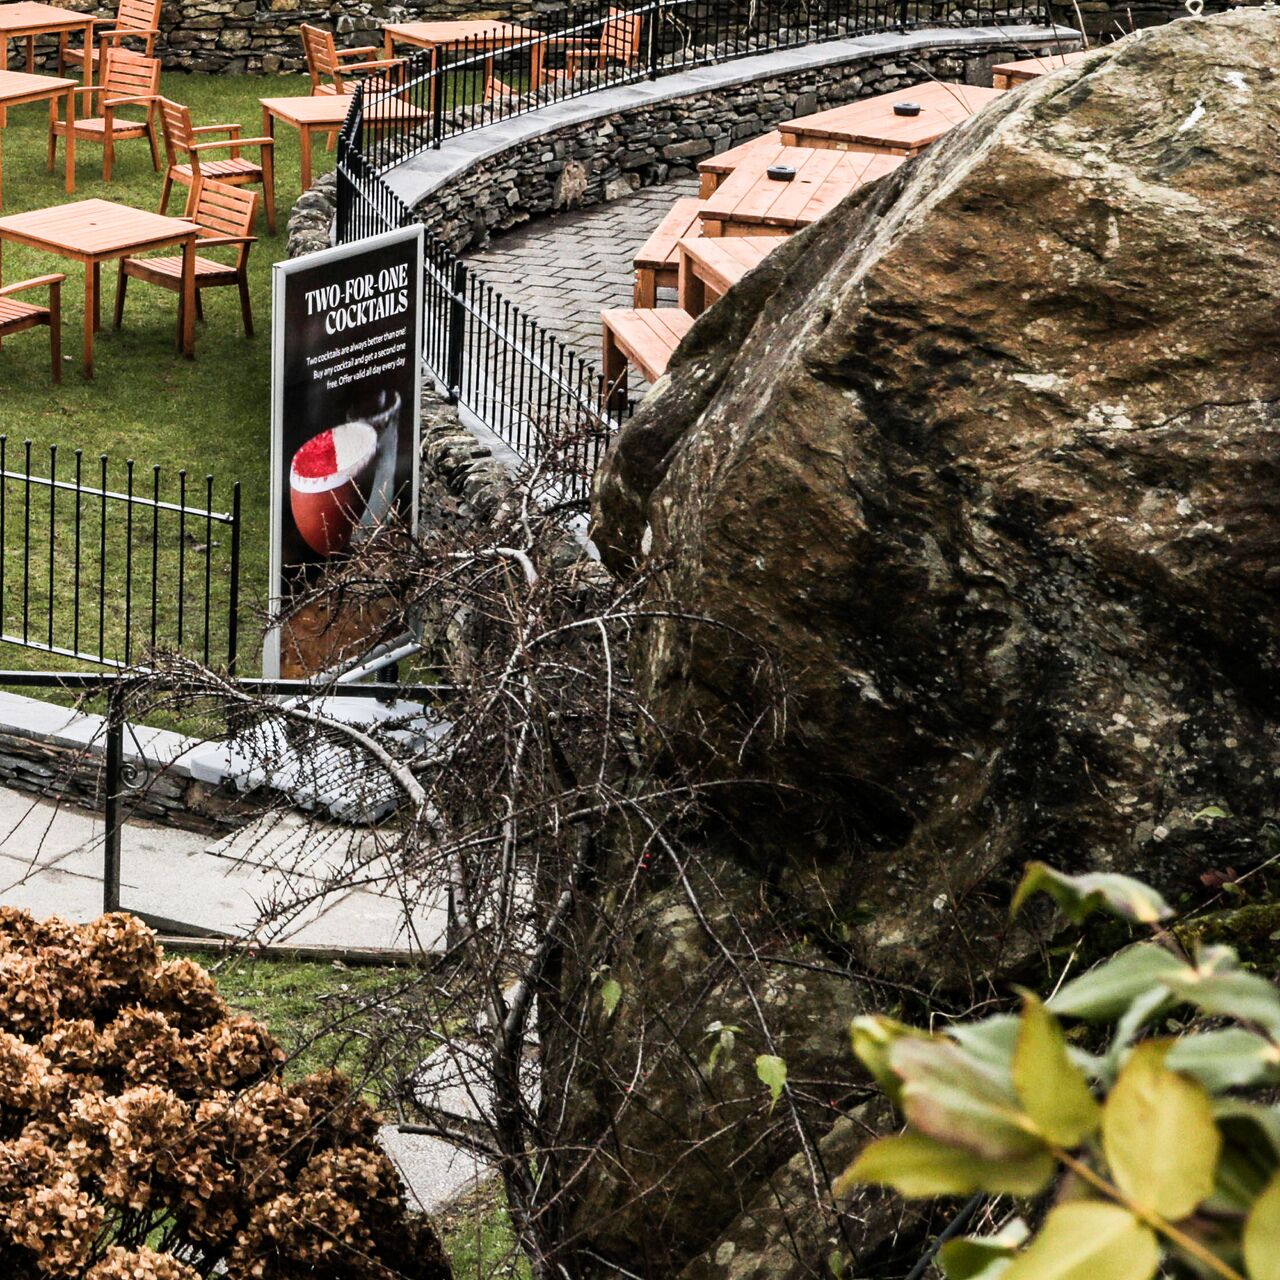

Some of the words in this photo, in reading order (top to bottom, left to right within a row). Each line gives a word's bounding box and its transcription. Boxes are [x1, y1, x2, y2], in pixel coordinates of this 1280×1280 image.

[305, 263, 408, 315] TWO-FOR-ONE
[325, 289, 408, 335] COCKTAILS
[306, 357, 317, 366] Two
[318, 348, 340, 363] cocktails
[341, 346, 349, 355] are
[350, 342, 367, 353] always
[368, 335, 383, 347] better
[384, 331, 395, 341] than
[313, 370, 323, 380] Buy
[323, 367, 333, 376] any
[334, 358, 354, 373] cocktail
[354, 354, 364, 365] and
[365, 353, 373, 364] get
[377, 344, 396, 358] second
[396, 342, 406, 352] one
[326, 380, 338, 390] free.
[339, 374, 353, 386] Offer
[353, 370, 365, 381] valid
[373, 365, 382, 375] day
[382, 361, 396, 371] every
[396, 357, 406, 367] day
